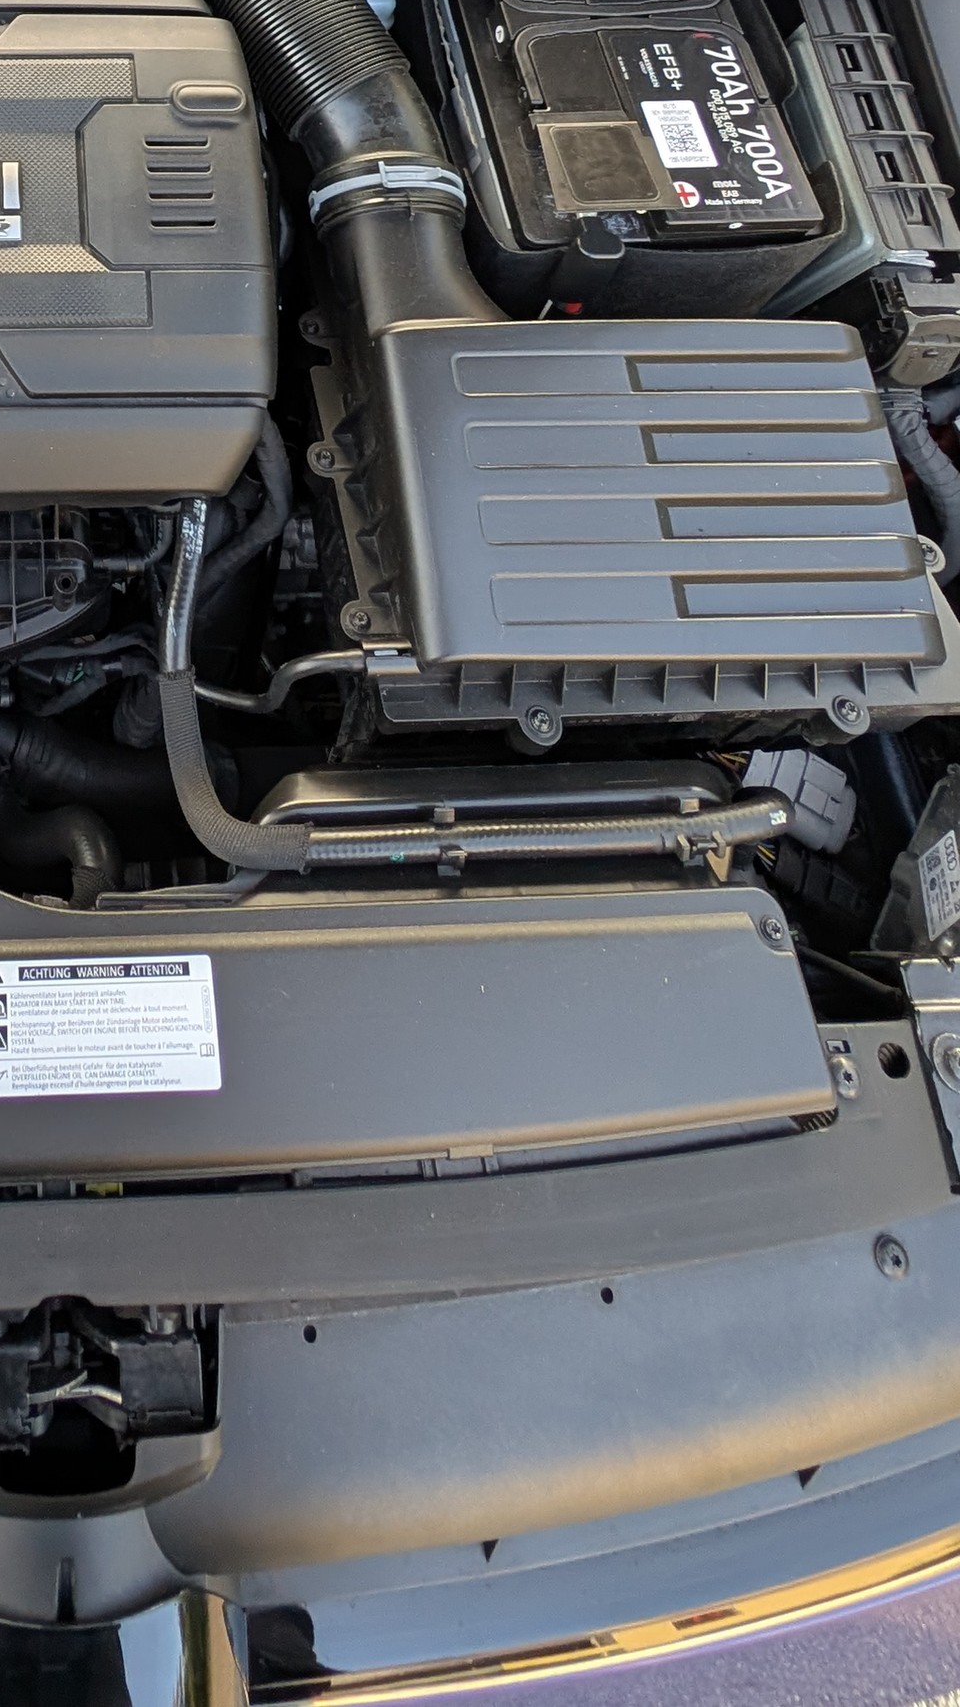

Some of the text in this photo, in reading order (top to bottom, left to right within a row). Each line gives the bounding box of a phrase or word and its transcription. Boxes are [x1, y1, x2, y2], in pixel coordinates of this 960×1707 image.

[653, 44, 684, 90] EFB+
[704, 45, 792, 199] 70Ah 700A
[709, 89, 744, 154] 000 915 089 AC
[705, 198, 724, 206] Made
[732, 197, 763, 206] Germany
[22, 964, 184, 981] ACHTUNG WARNING ATTENTION
[57, 1028, 80, 1036] SWITCH
[84, 1044, 105, 1052] moteur
[134, 1042, 156, 1050] toucher
[12, 1073, 46, 1081] OVERFILLED
[48, 1072, 71, 1080] ENGINE
[84, 1071, 98, 1079] CAN
[99, 1070, 126, 1078] DAMAGE
[129, 1080, 143, 1088] pour
